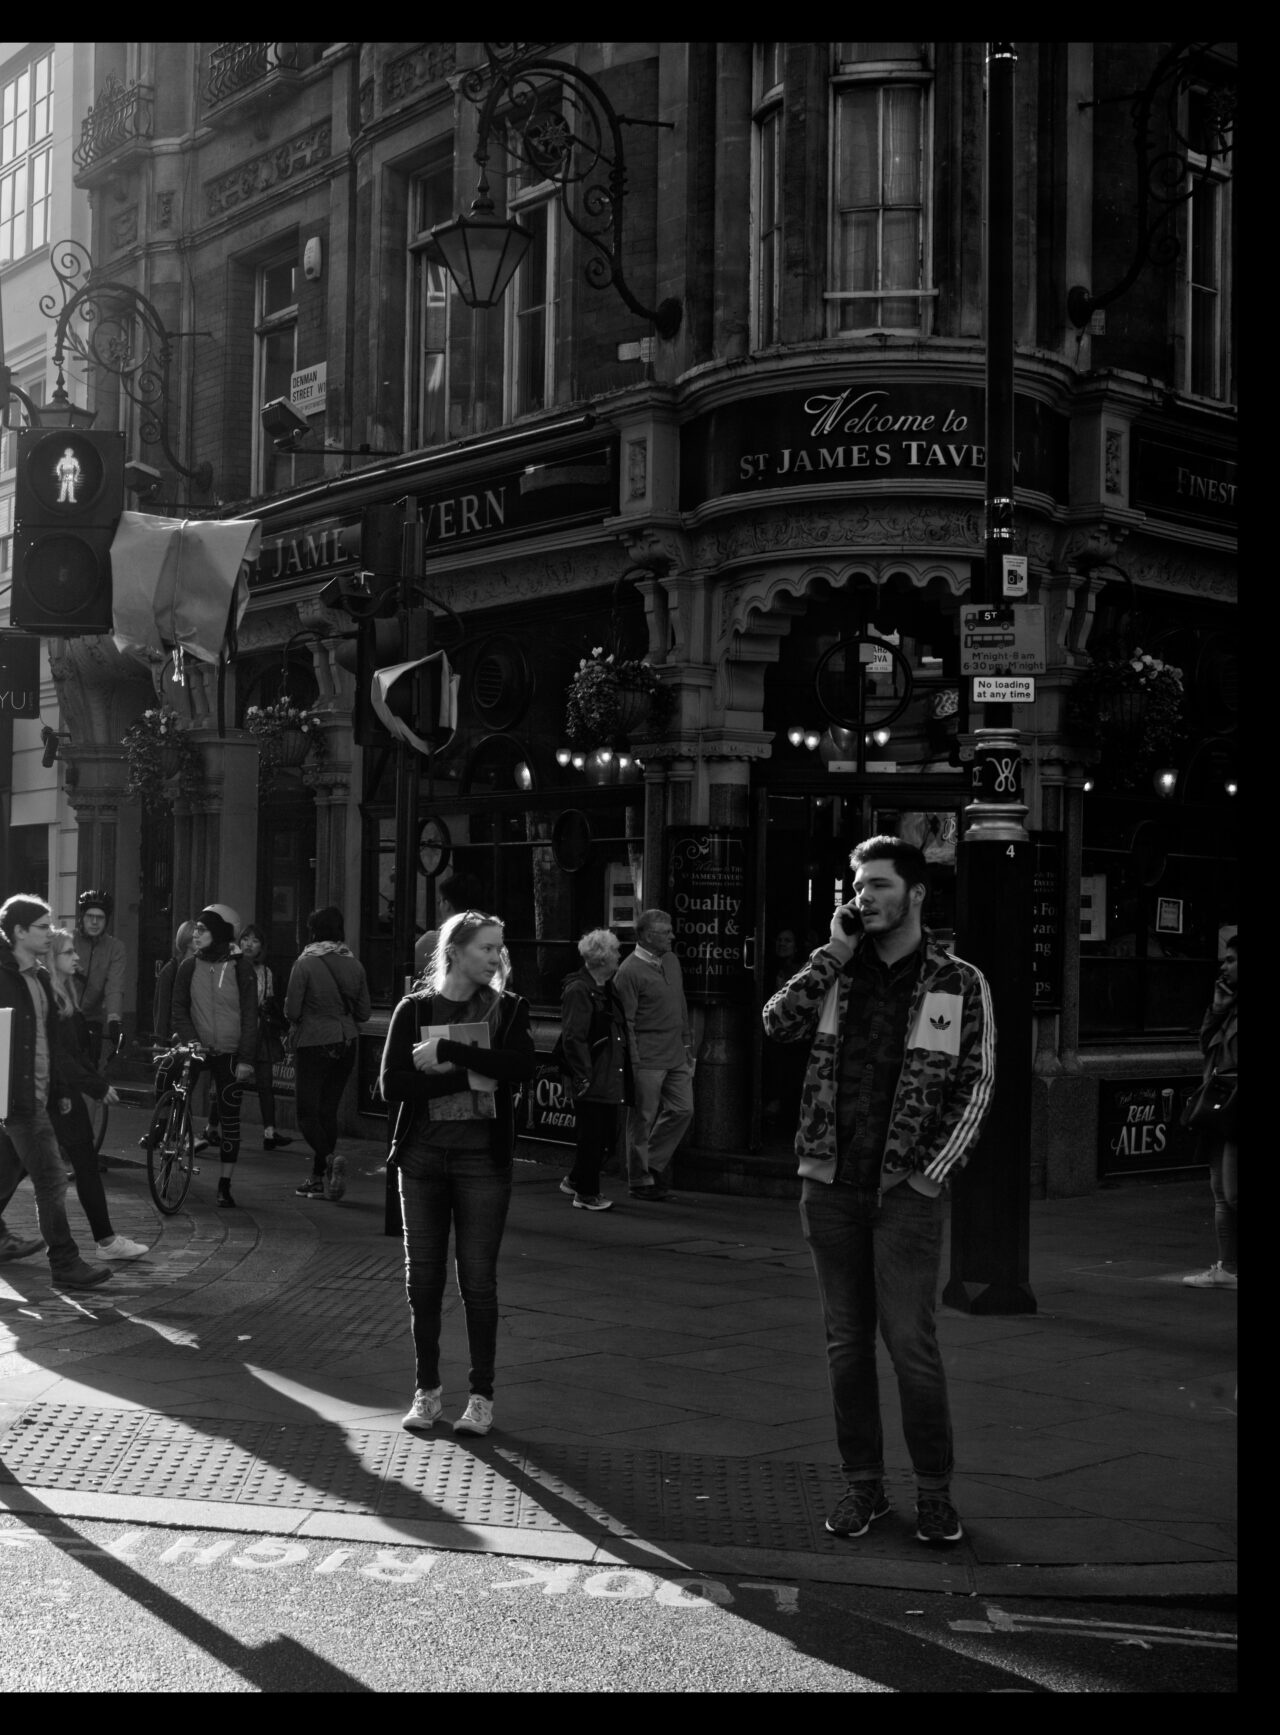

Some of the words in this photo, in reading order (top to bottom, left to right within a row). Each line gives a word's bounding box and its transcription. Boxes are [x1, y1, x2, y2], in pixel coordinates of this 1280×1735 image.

[292, 370, 318, 389] DENMAN
[292, 385, 313, 402] STREET
[804, 387, 936, 437] Welcome
[942, 408, 968, 433] to
[777, 443, 892, 474] JAMES
[1175, 466, 1239, 506] FINEST
[272, 527, 360, 578] JAME
[978, 681, 992, 689] No
[995, 681, 1030, 690] loading
[1010, 691, 1031, 699] time
[1005, 844, 1016, 858] 4
[674, 892, 742, 916] Quality
[676, 918, 719, 936] Food
[724, 918, 741, 936] &
[673, 940, 741, 960] Coffees
[536, 1078, 575, 1109] CRA
[540, 1111, 577, 1129] LAGERS
[1126, 1104, 1156, 1123] REAL
[1111, 1123, 1167, 1156] ALES
[67, 1530, 438, 1584] RIGHT
[491, 1561, 801, 1615] LOOK
